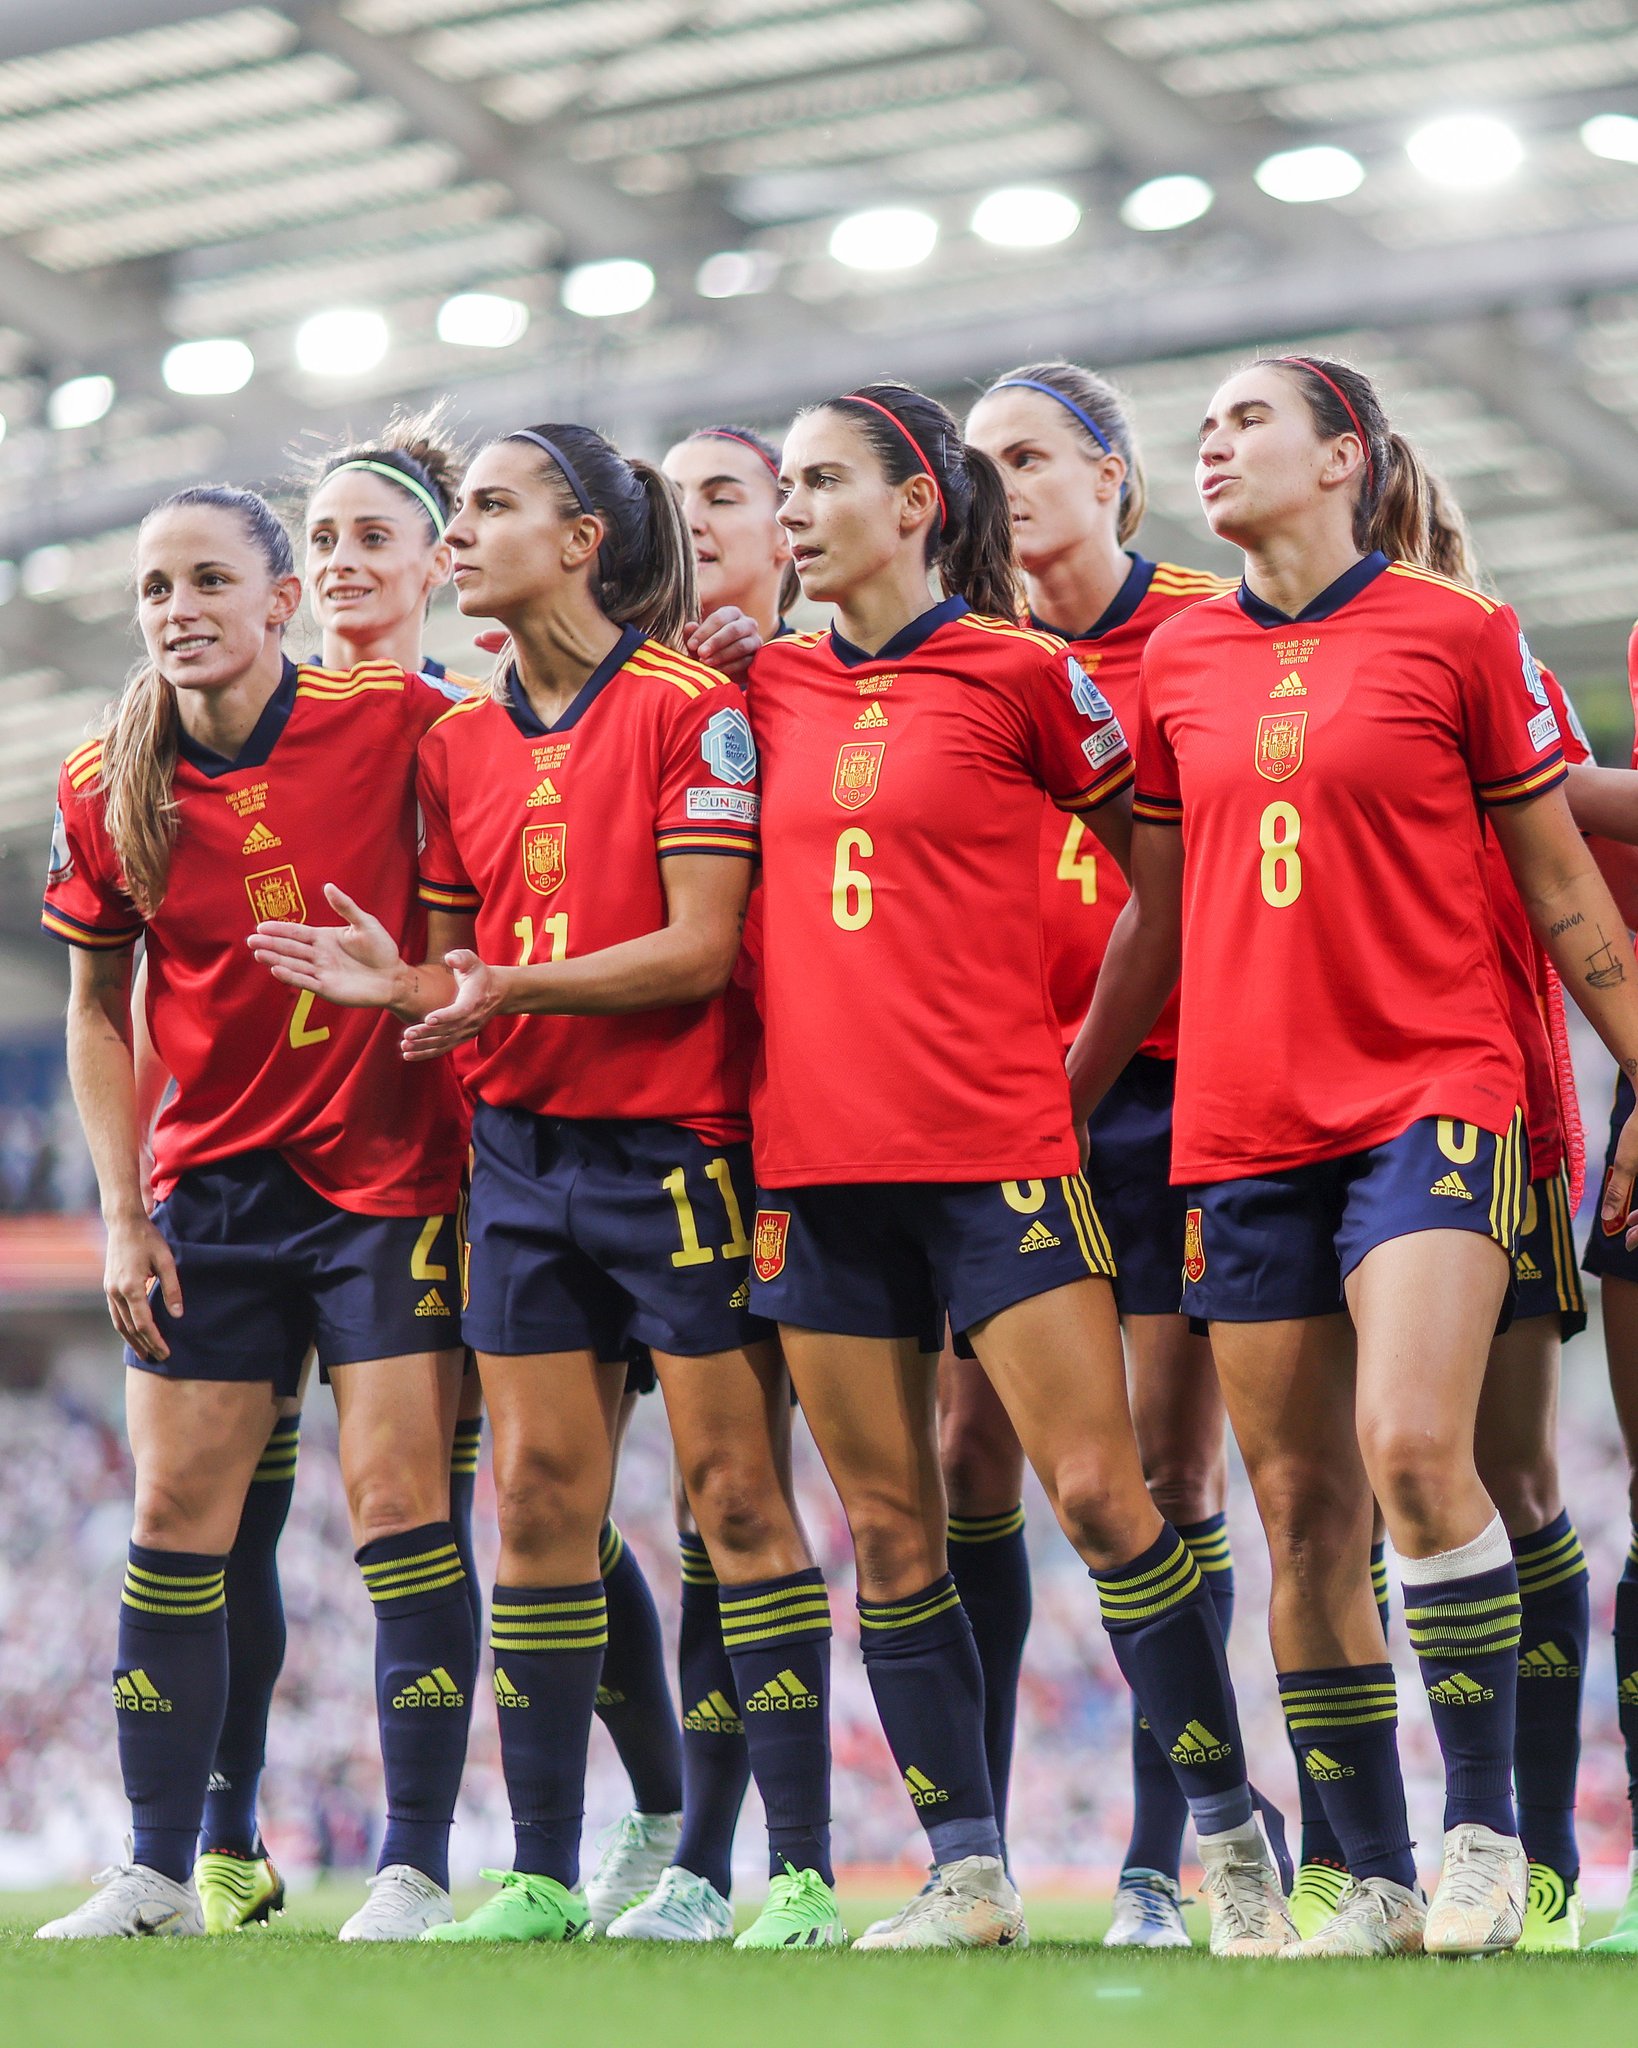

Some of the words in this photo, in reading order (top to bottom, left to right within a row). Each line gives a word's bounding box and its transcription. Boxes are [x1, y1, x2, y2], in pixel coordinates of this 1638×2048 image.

[1272, 638, 1320, 651] ENGLAND-SPAIN
[1276, 650, 1284, 659] 20
[1285, 649, 1299, 657] JULY
[1299, 647, 1314, 656] 2022
[1279, 655, 1309, 666] BRIGHTON
[1269, 686, 1308, 699] adidas
[853, 717, 889, 730] adidas
[526, 794, 562, 808] adidas
[242, 836, 282, 856] adidas
[1259, 800, 1302, 908] 8
[1056, 814, 1098, 905] 4
[832, 827, 874, 931] 6
[1429, 1185, 1473, 1200] adidas
[662, 1157, 753, 1268] 11
[1018, 1235, 1061, 1254] adidas
[414, 1305, 451, 1317] adidas
[1519, 1662, 1580, 1678] didas
[392, 1690, 465, 1710] adidas
[746, 1693, 819, 1713] adidas
[1425, 1687, 1495, 1706] adidas
[1169, 1742, 1233, 1765] adidas
[913, 1788, 950, 1807] das
